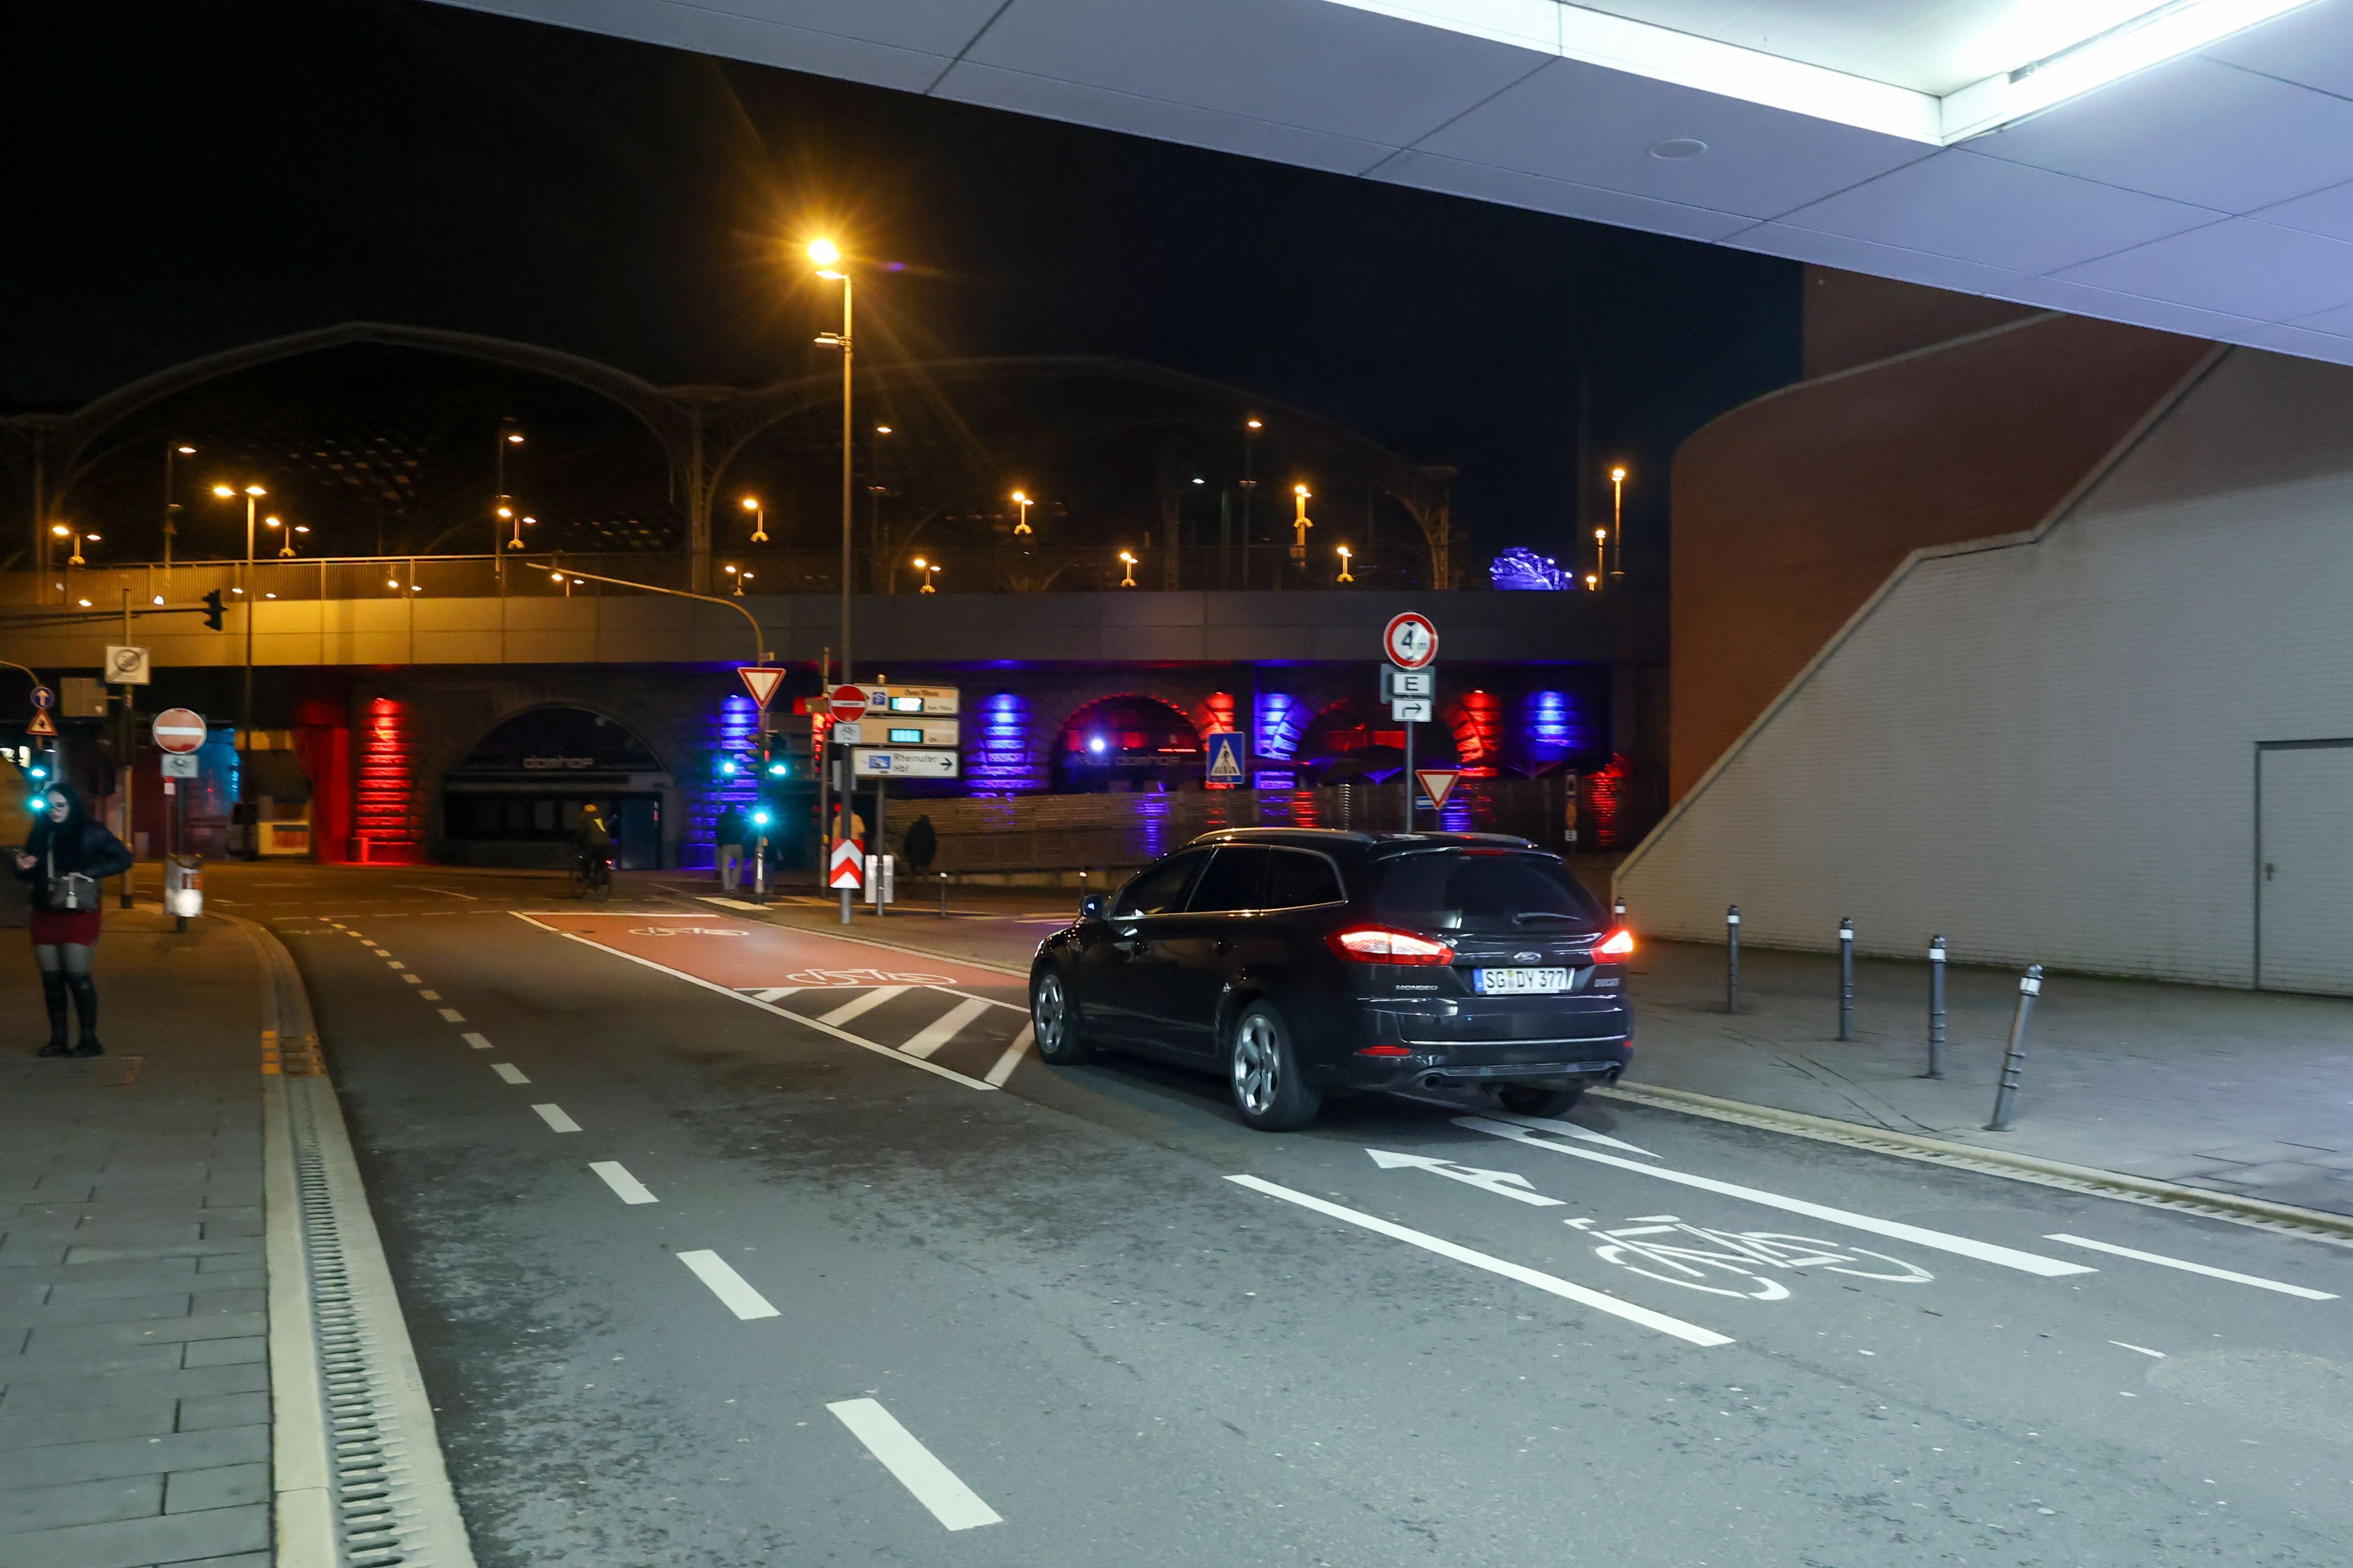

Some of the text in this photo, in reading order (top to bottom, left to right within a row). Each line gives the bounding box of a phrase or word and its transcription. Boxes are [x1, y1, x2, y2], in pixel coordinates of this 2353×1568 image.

[1405, 676, 1419, 691] E
[1486, 970, 1564, 989] SG DY 377
